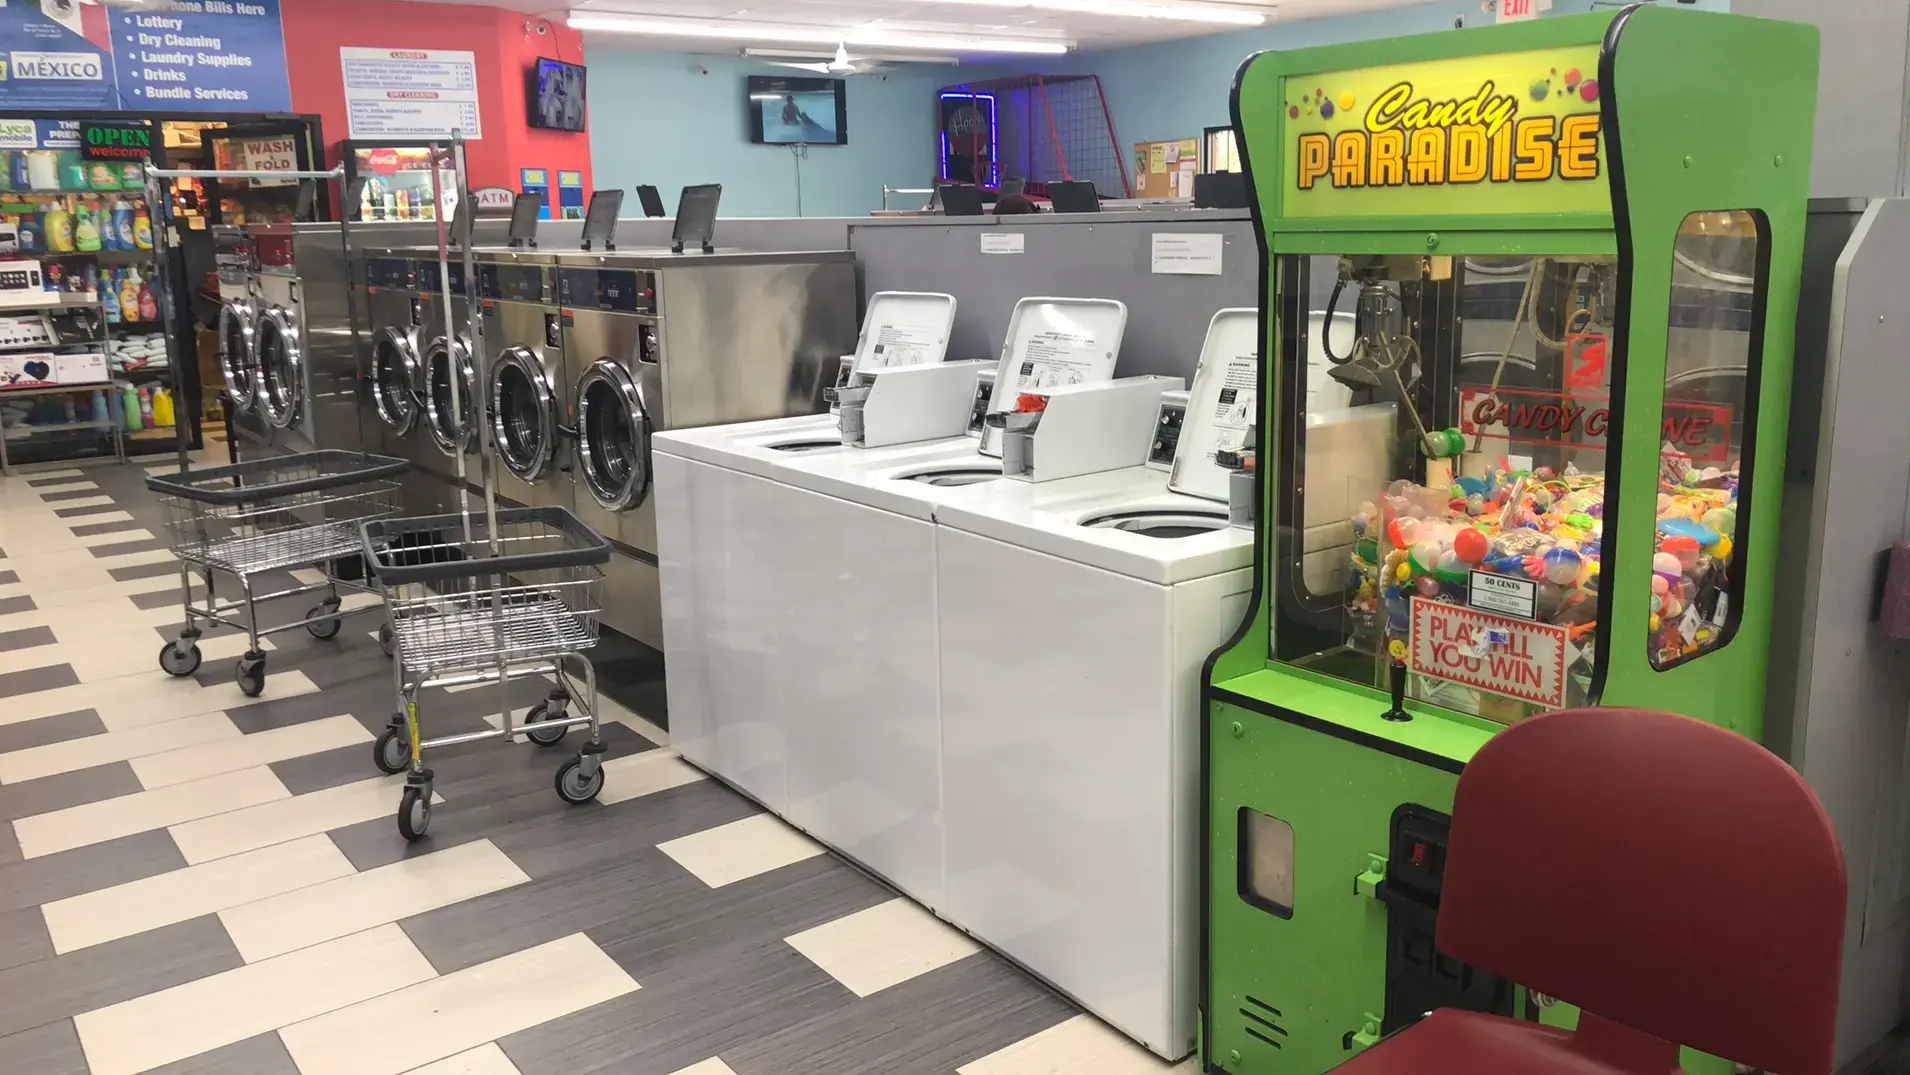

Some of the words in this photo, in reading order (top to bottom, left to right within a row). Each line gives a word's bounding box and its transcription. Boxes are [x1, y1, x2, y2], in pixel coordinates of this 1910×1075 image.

[206, 1, 234, 14] Bills
[237, 4, 266, 16] Here
[136, 15, 183, 31] Lottery
[138, 33, 162, 48] Dry
[165, 35, 222, 50] Cleaning
[141, 51, 194, 65] Laundry
[197, 52, 252, 67] Supplies
[144, 69, 187, 82] Drinks
[145, 85, 192, 99] Bundle
[195, 86, 249, 101] Services
[1365, 80, 1518, 138] Candy
[49, 130, 81, 139] PREP
[87, 127, 151, 146] OPEN
[89, 146, 152, 157] welcome
[247, 141, 294, 155] WASH
[1297, 112, 1600, 189] PARADISE
[255, 159, 291, 171] FOLD
[481, 193, 509, 203] ATM
[1472, 399, 1585, 433] CANDY
[1484, 577, 1495, 586] 50
[1496, 579, 1521, 591] CENTS
[1430, 615, 1484, 647] PLAY
[1428, 640, 1482, 673] YOU
[1487, 653, 1543, 689] WIN
